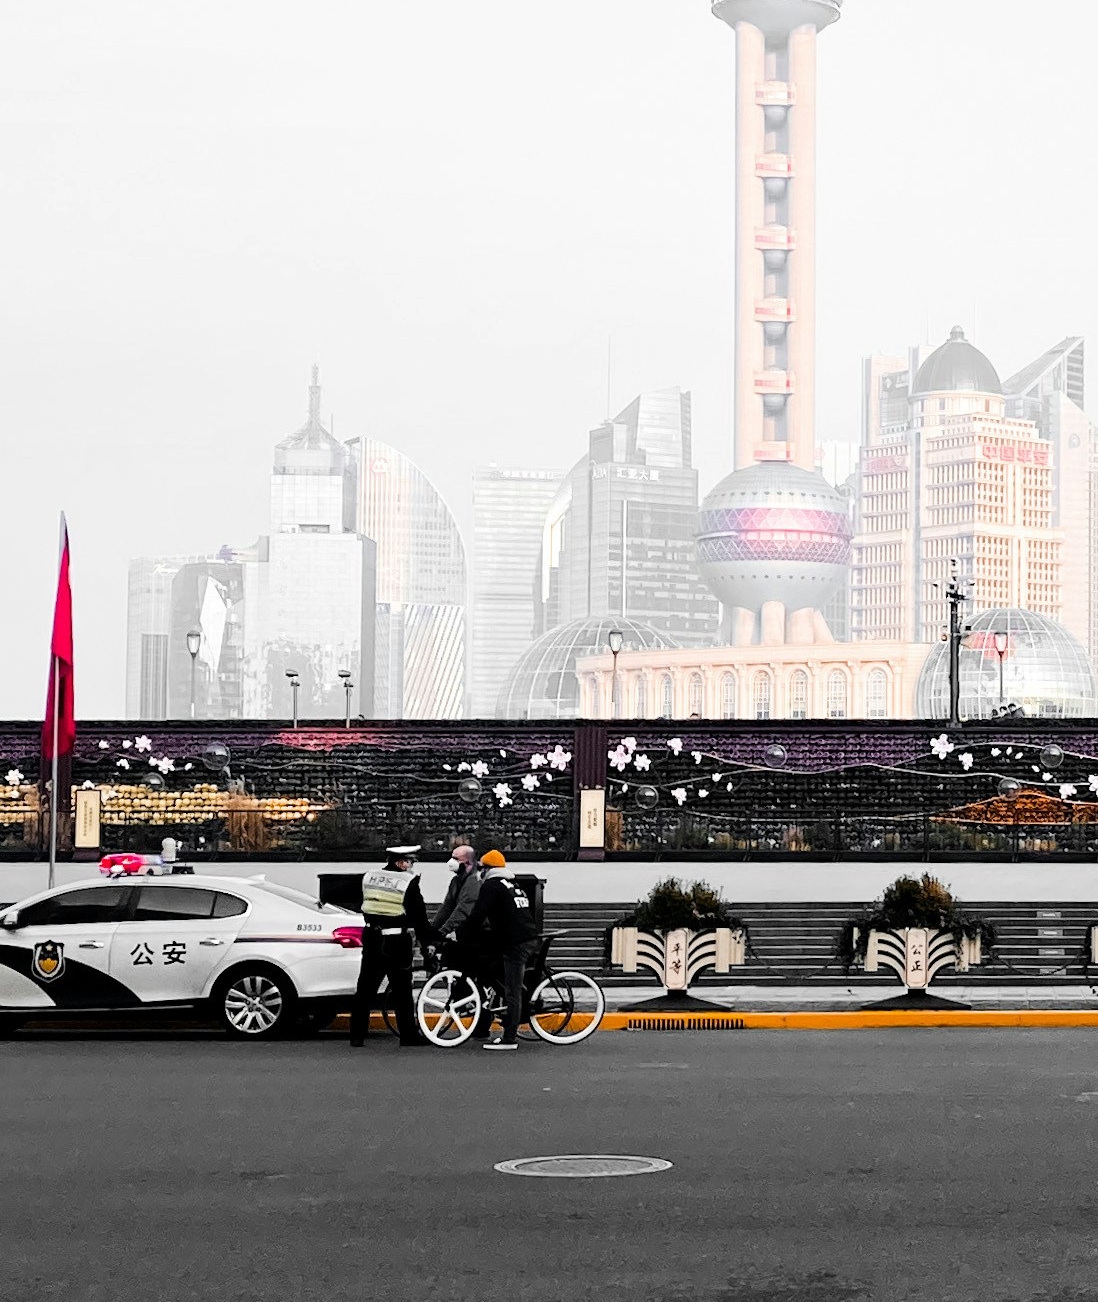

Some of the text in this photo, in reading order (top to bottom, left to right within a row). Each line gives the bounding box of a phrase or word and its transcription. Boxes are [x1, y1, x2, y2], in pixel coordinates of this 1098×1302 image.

[616, 467, 660, 481] 汇亚大厦
[296, 923, 322, 932] B3533
[130, 941, 187, 966] 公安
[669, 942, 683, 975] 平等
[911, 944, 924, 973] 公正
